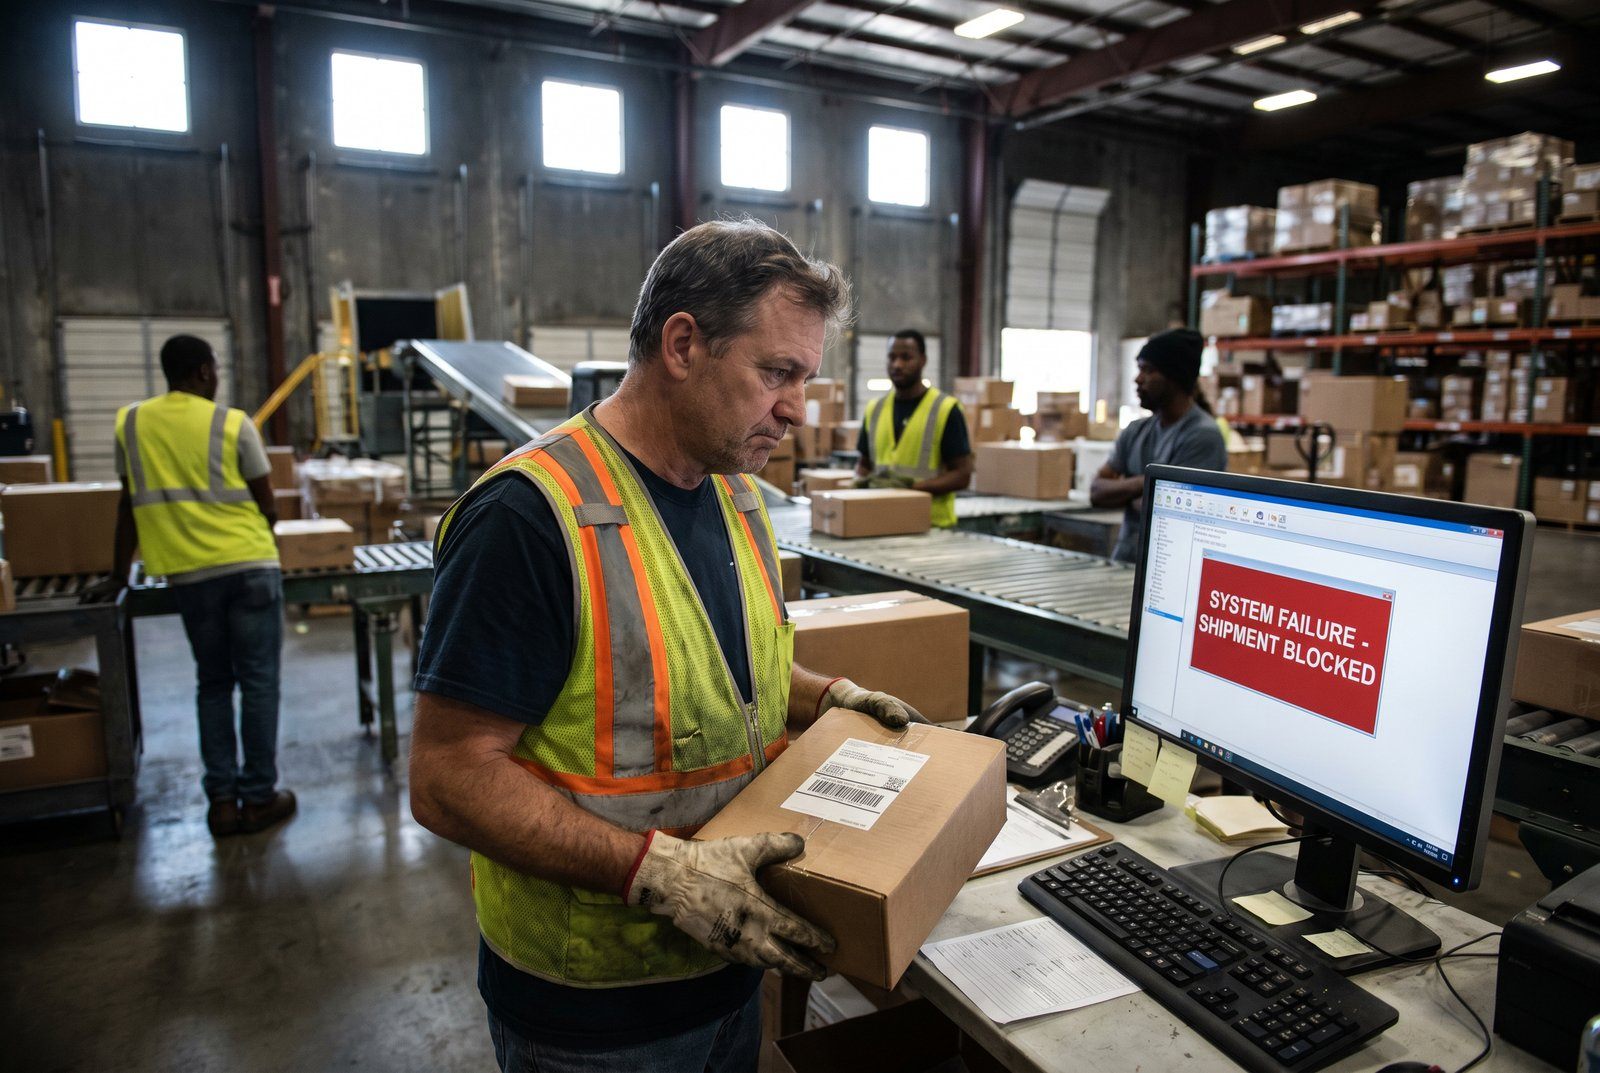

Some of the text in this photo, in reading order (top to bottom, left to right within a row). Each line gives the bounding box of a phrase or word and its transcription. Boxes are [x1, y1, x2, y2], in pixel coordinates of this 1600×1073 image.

[1198, 613, 1376, 686] SHIPMENT BLOCKED
[1209, 589, 1274, 625] SYSTEM
[1277, 607, 1357, 649] FAILURE
